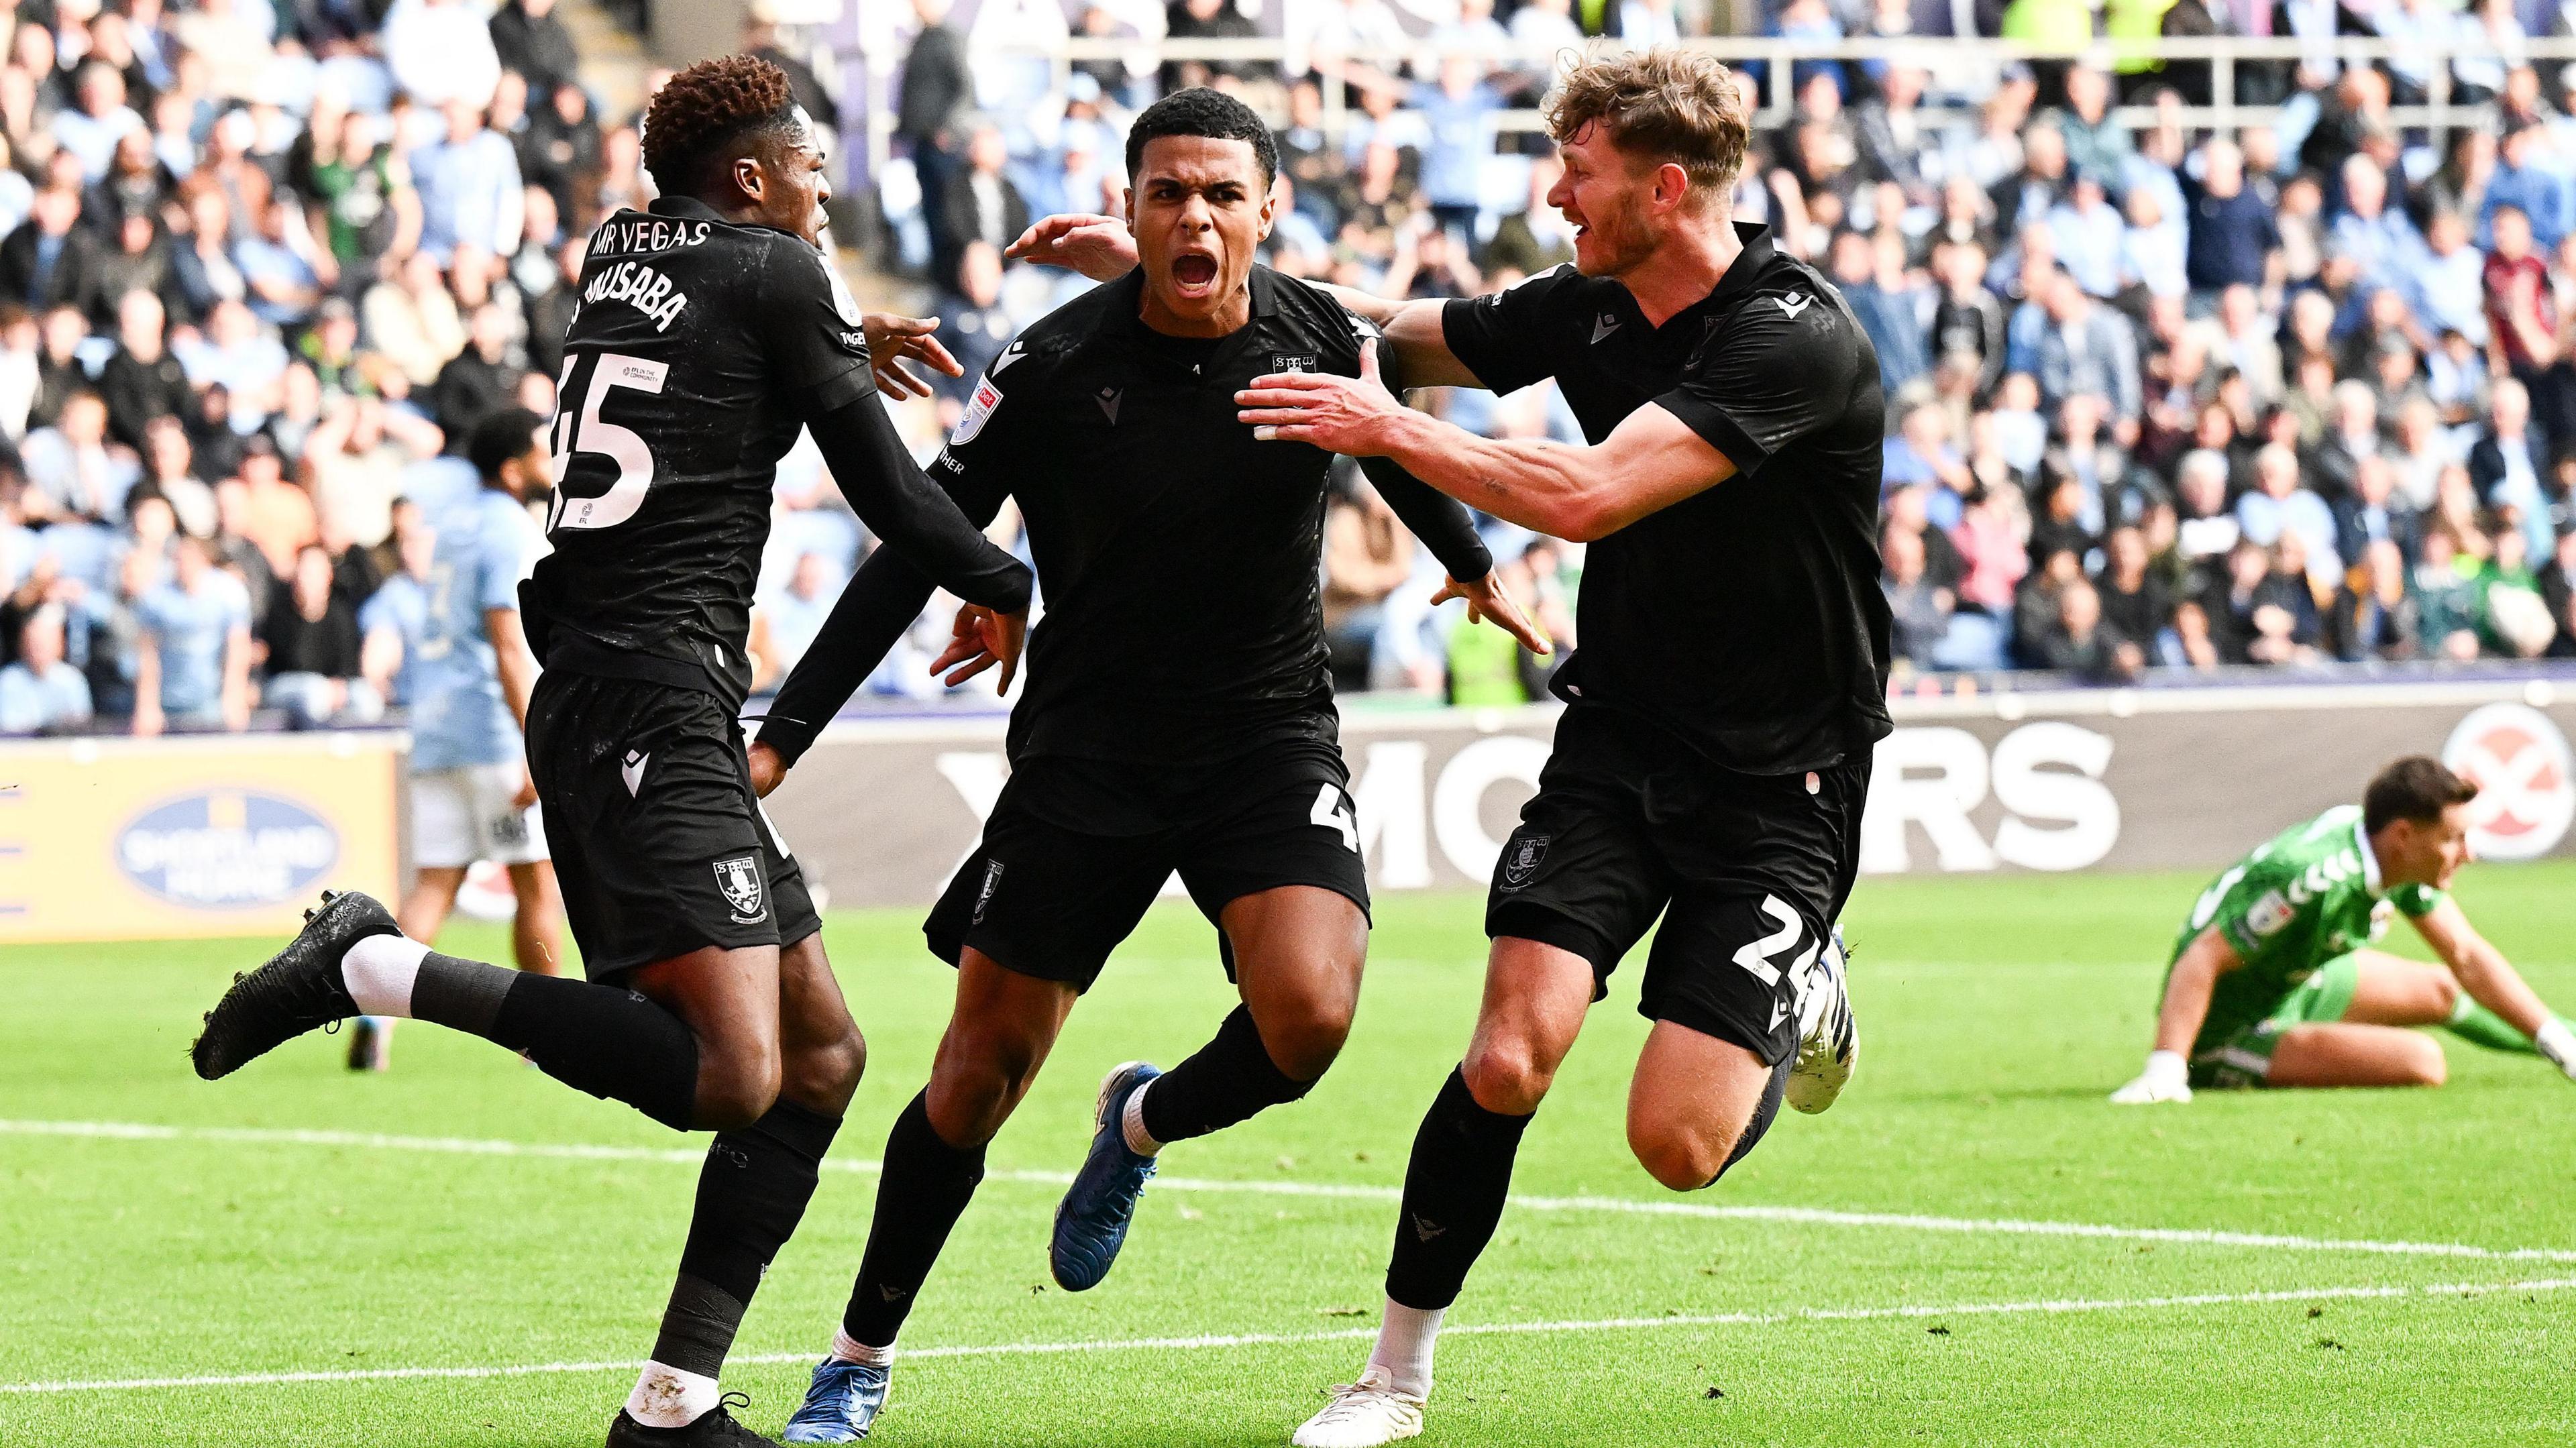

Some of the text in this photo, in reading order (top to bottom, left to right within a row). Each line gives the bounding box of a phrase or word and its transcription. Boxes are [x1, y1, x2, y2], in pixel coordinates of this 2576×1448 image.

[592, 221, 711, 255] MR VEGAS
[584, 261, 688, 333] MUSABA
[979, 388, 995, 405] bet
[1309, 782, 1358, 854] 4
[1731, 893, 1821, 1018] 24
